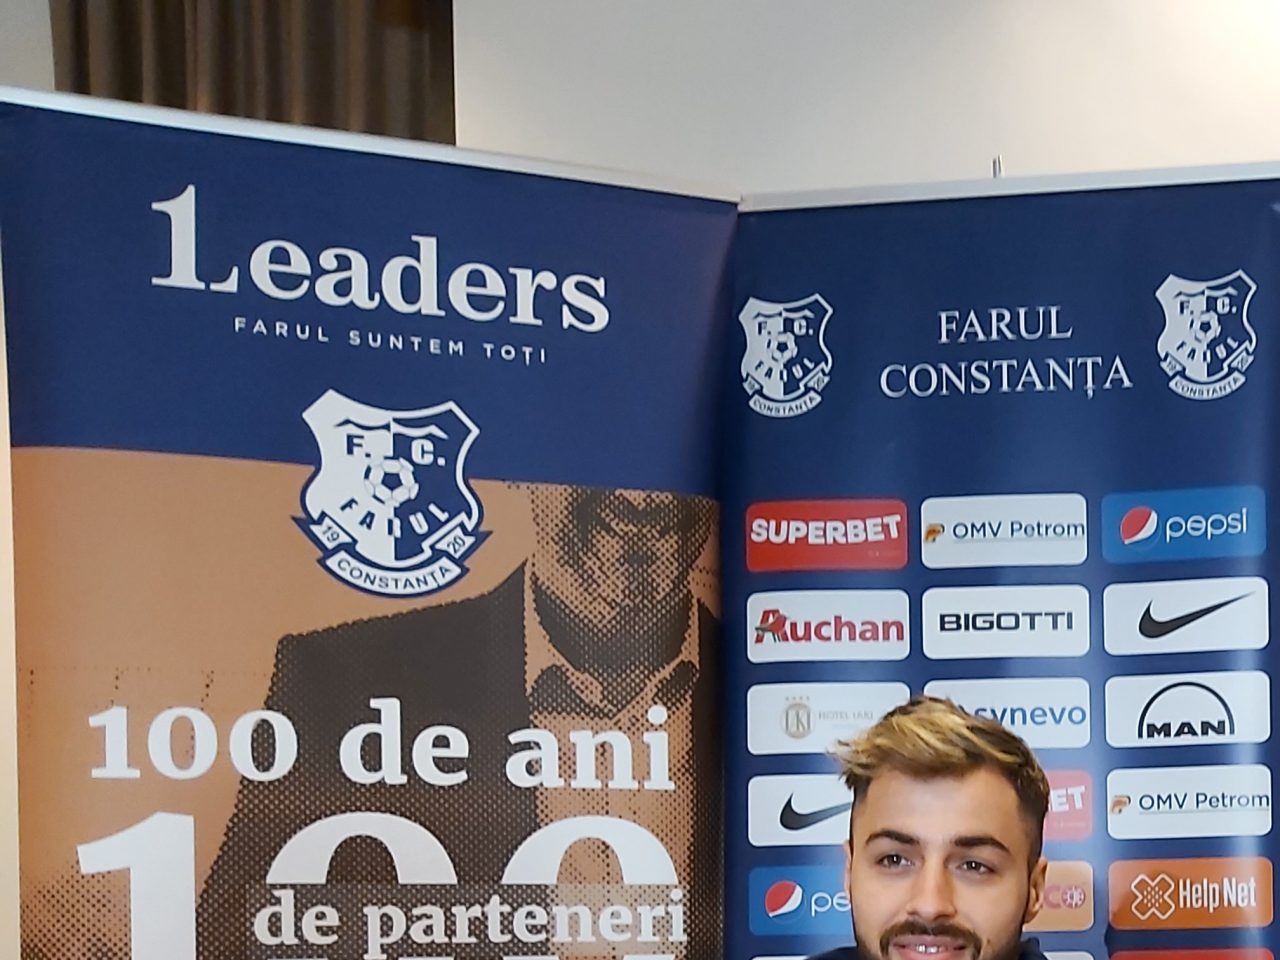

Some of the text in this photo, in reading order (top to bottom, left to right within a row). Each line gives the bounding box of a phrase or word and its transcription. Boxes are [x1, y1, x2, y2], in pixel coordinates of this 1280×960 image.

[234, 316, 330, 343] FARUL
[349, 329, 465, 357] SUNTEM
[937, 306, 1074, 345] FARUL
[879, 355, 1134, 400] CONSTANȚA
[750, 514, 902, 545] SUPERBET
[952, 519, 1086, 540] OMV Petrom
[1166, 508, 1248, 543] pepsi
[754, 609, 905, 644] Auchan
[939, 611, 1074, 632] BIGOTTI
[88, 697, 676, 792] 100 de ani
[1146, 720, 1226, 739] MAN
[1139, 792, 1270, 811] OMV Petrom
[1179, 876, 1257, 913] Help Net
[253, 889, 688, 960] de parteneri
